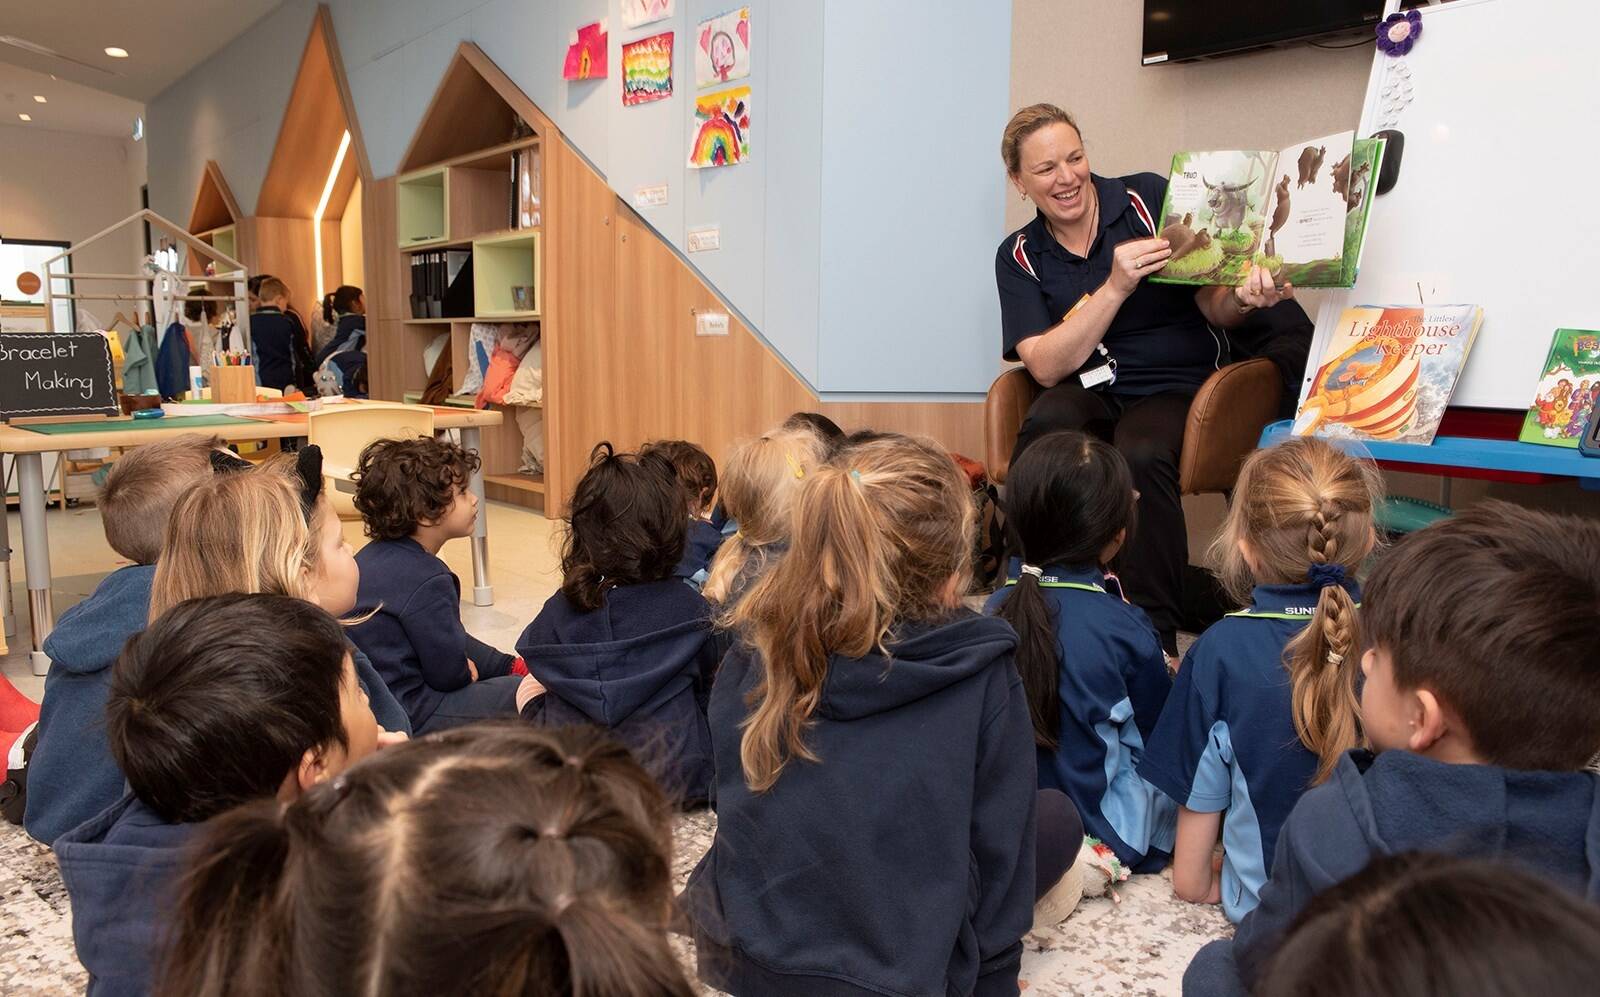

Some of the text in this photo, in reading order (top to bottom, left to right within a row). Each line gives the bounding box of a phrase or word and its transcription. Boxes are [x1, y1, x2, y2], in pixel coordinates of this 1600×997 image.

[1428, 313, 1457, 323] Littlest
[1349, 320, 1461, 343] Lighthouse
[1375, 340, 1448, 361] Keeper
[25, 370, 93, 400] Making
